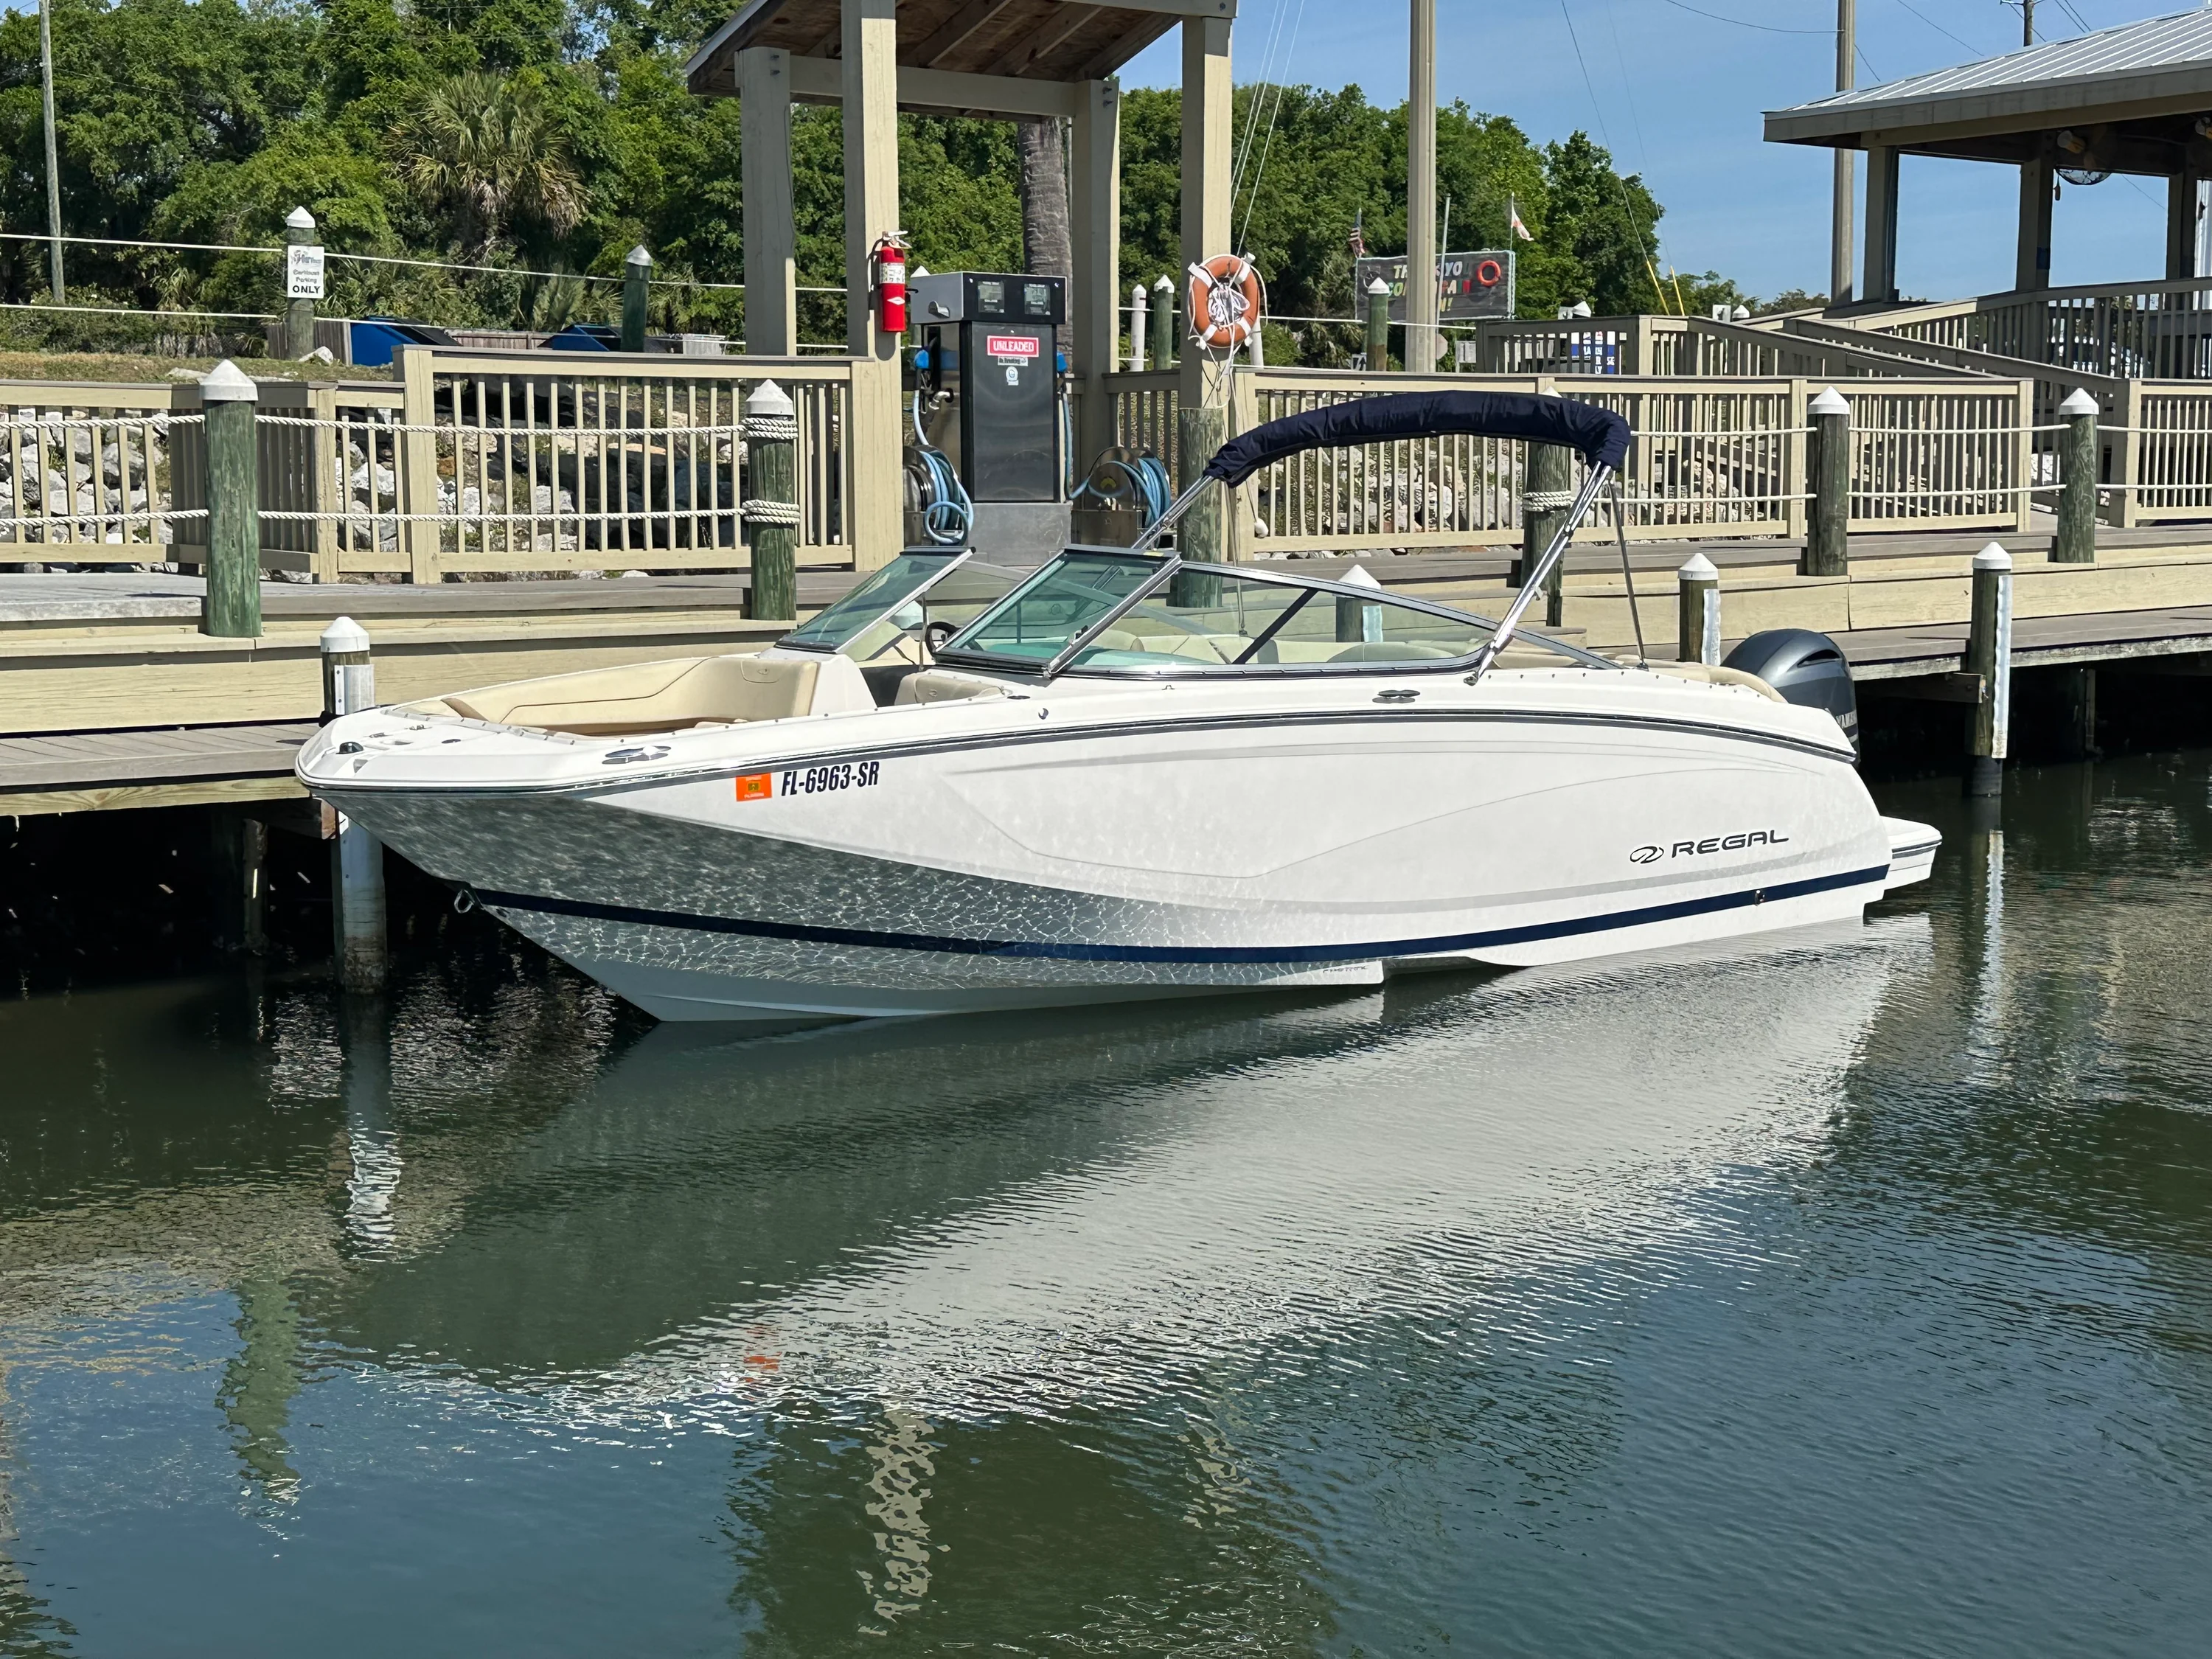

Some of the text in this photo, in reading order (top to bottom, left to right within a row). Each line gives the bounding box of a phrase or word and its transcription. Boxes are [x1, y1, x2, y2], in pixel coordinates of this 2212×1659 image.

[292, 285, 321, 294] ONLY
[992, 340, 1034, 352] UNLEADED
[781, 761, 880, 796] FL-6963-SR
[1671, 830, 1790, 858] REGAL
